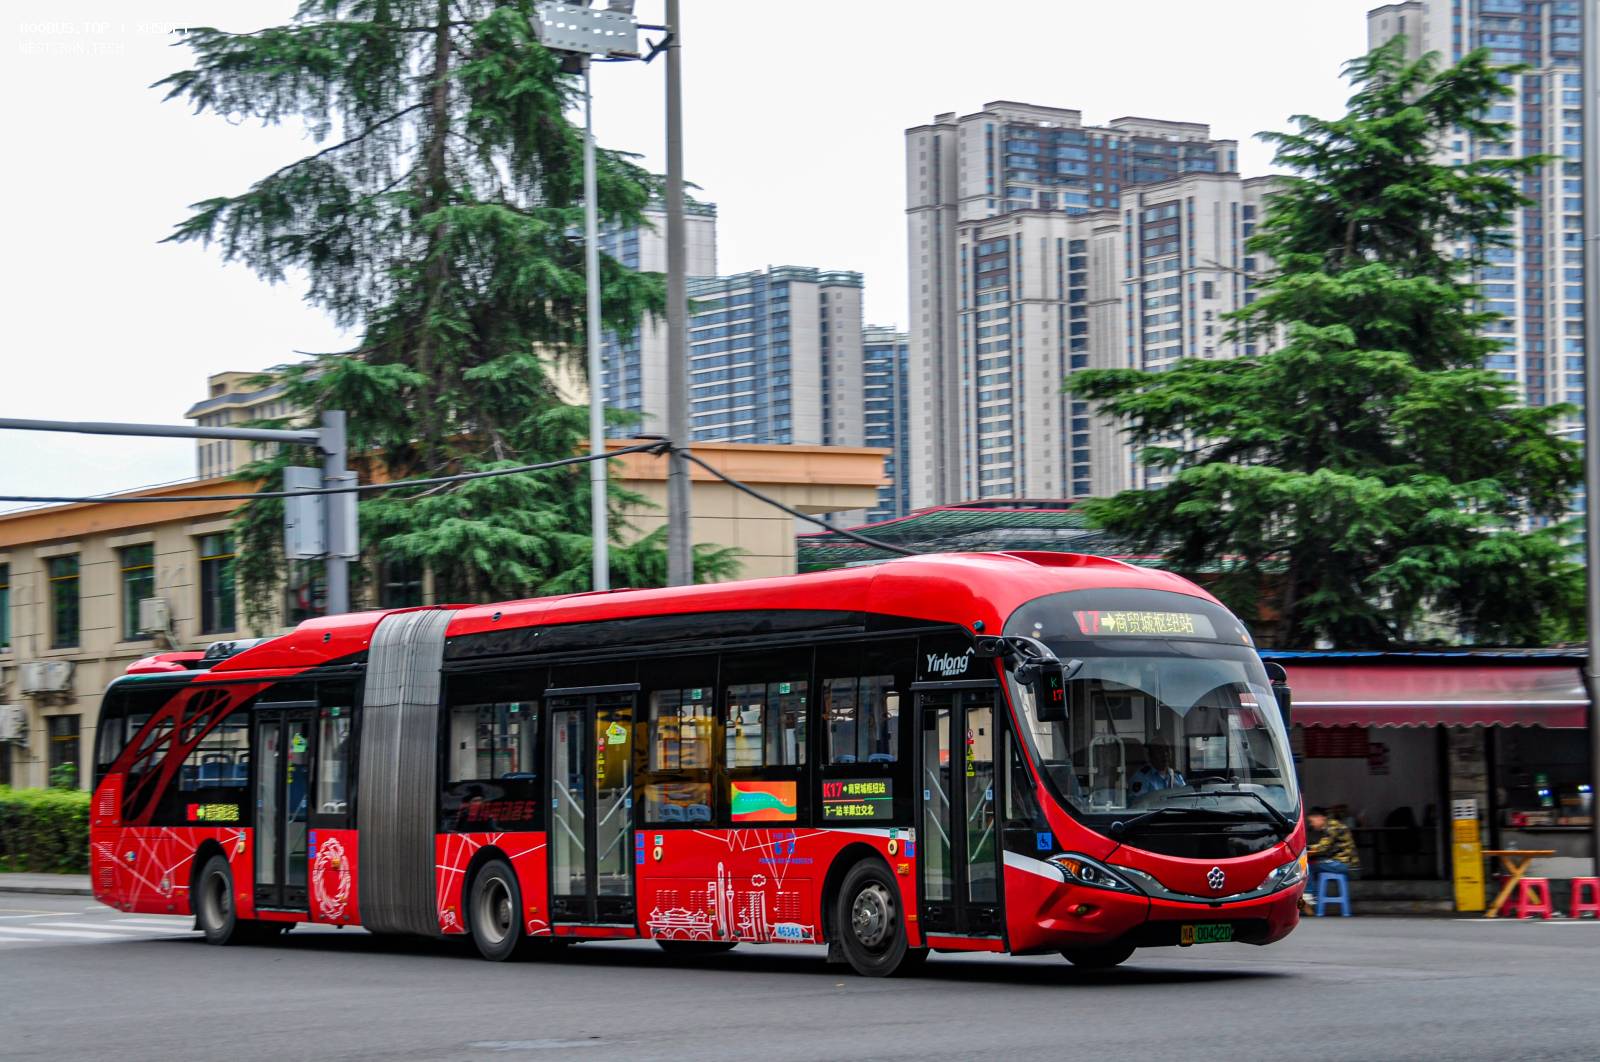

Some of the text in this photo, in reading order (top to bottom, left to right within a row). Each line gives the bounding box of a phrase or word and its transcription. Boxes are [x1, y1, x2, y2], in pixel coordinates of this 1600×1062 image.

[1115, 612, 1195, 634] 商贸城枢纽站
[926, 652, 969, 672] Yinlong
[1053, 689, 1064, 701] 17
[823, 782, 844, 798] K17
